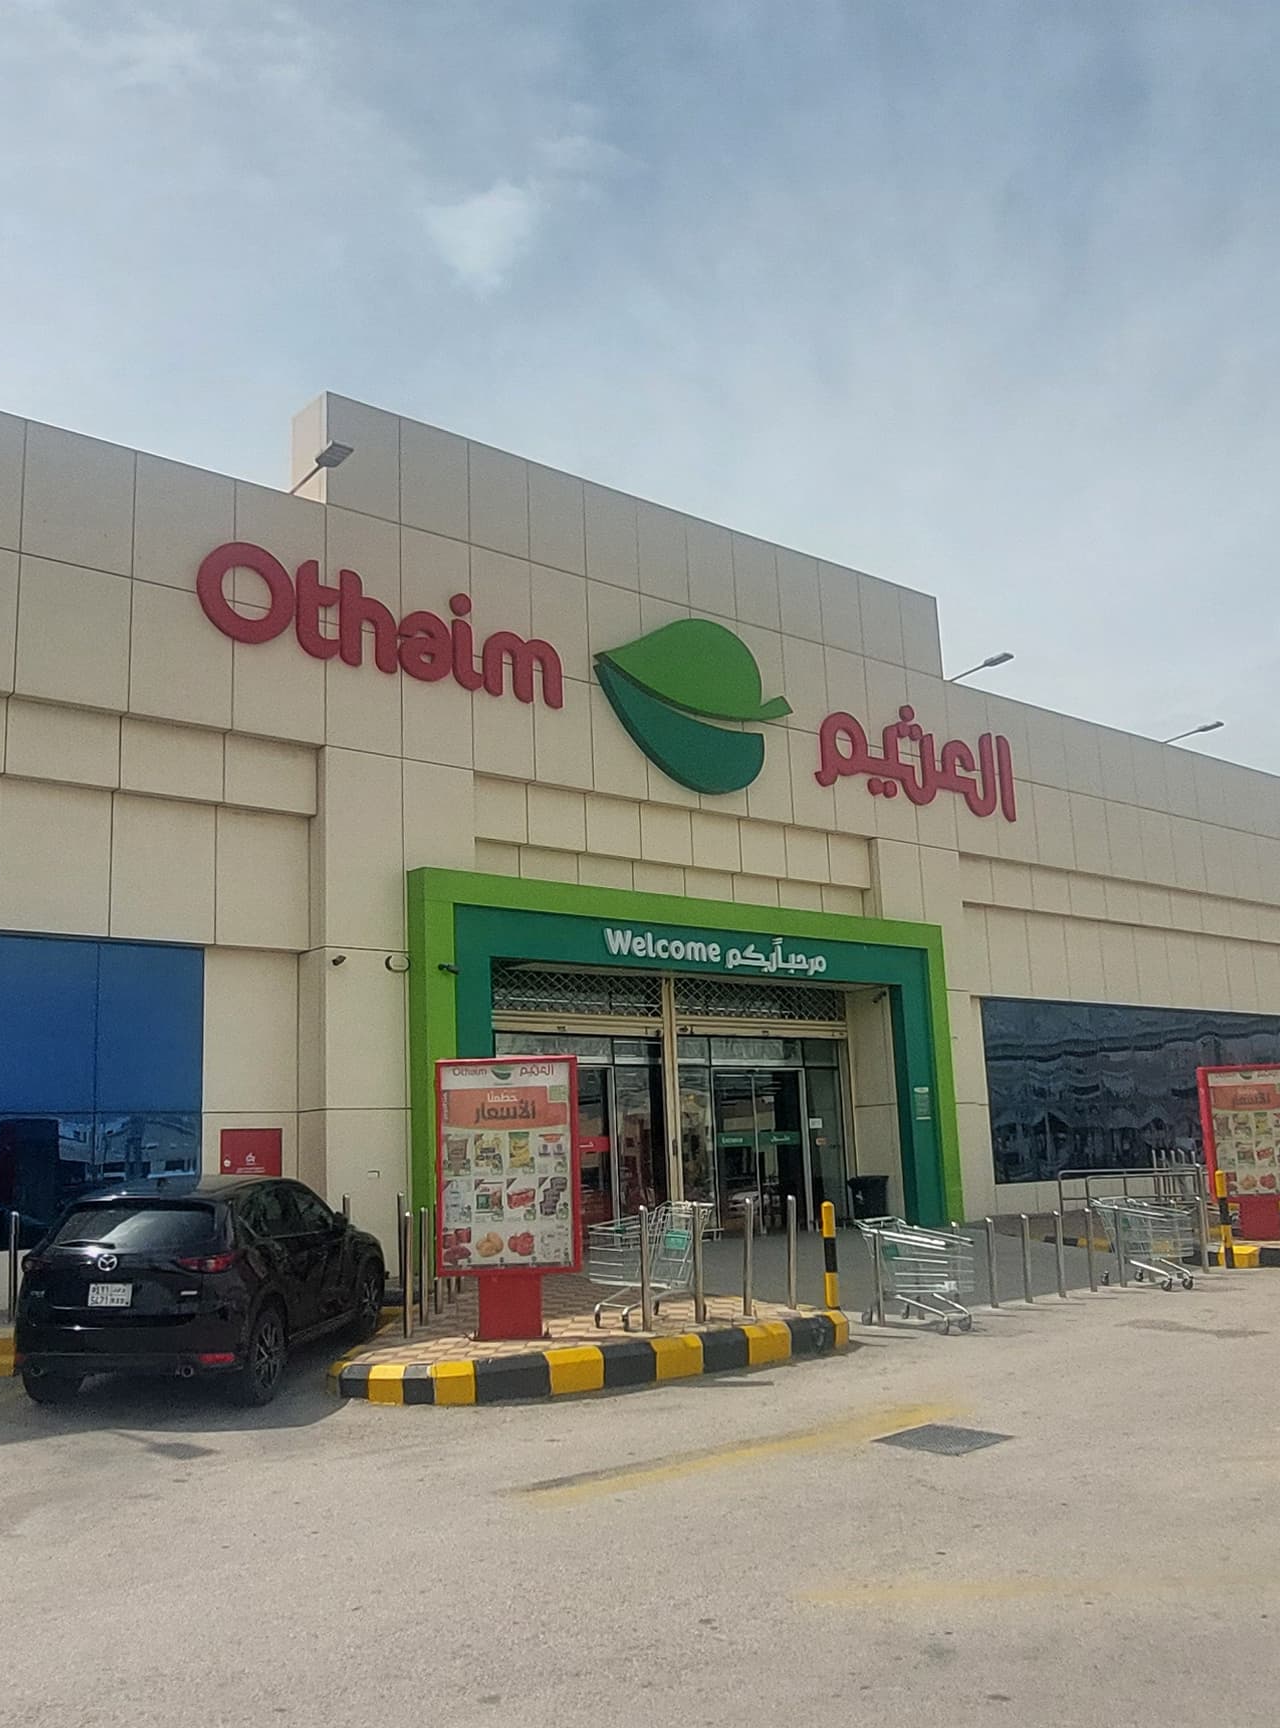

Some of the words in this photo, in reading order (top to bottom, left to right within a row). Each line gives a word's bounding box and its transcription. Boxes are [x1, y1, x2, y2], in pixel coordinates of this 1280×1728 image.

[196, 541, 563, 709] Othaim
[815, 704, 1016, 822] العثيم
[603, 927, 721, 962] Welcome
[725, 944, 777, 973] بكم
[475, 1100, 537, 1124] الأسعار
